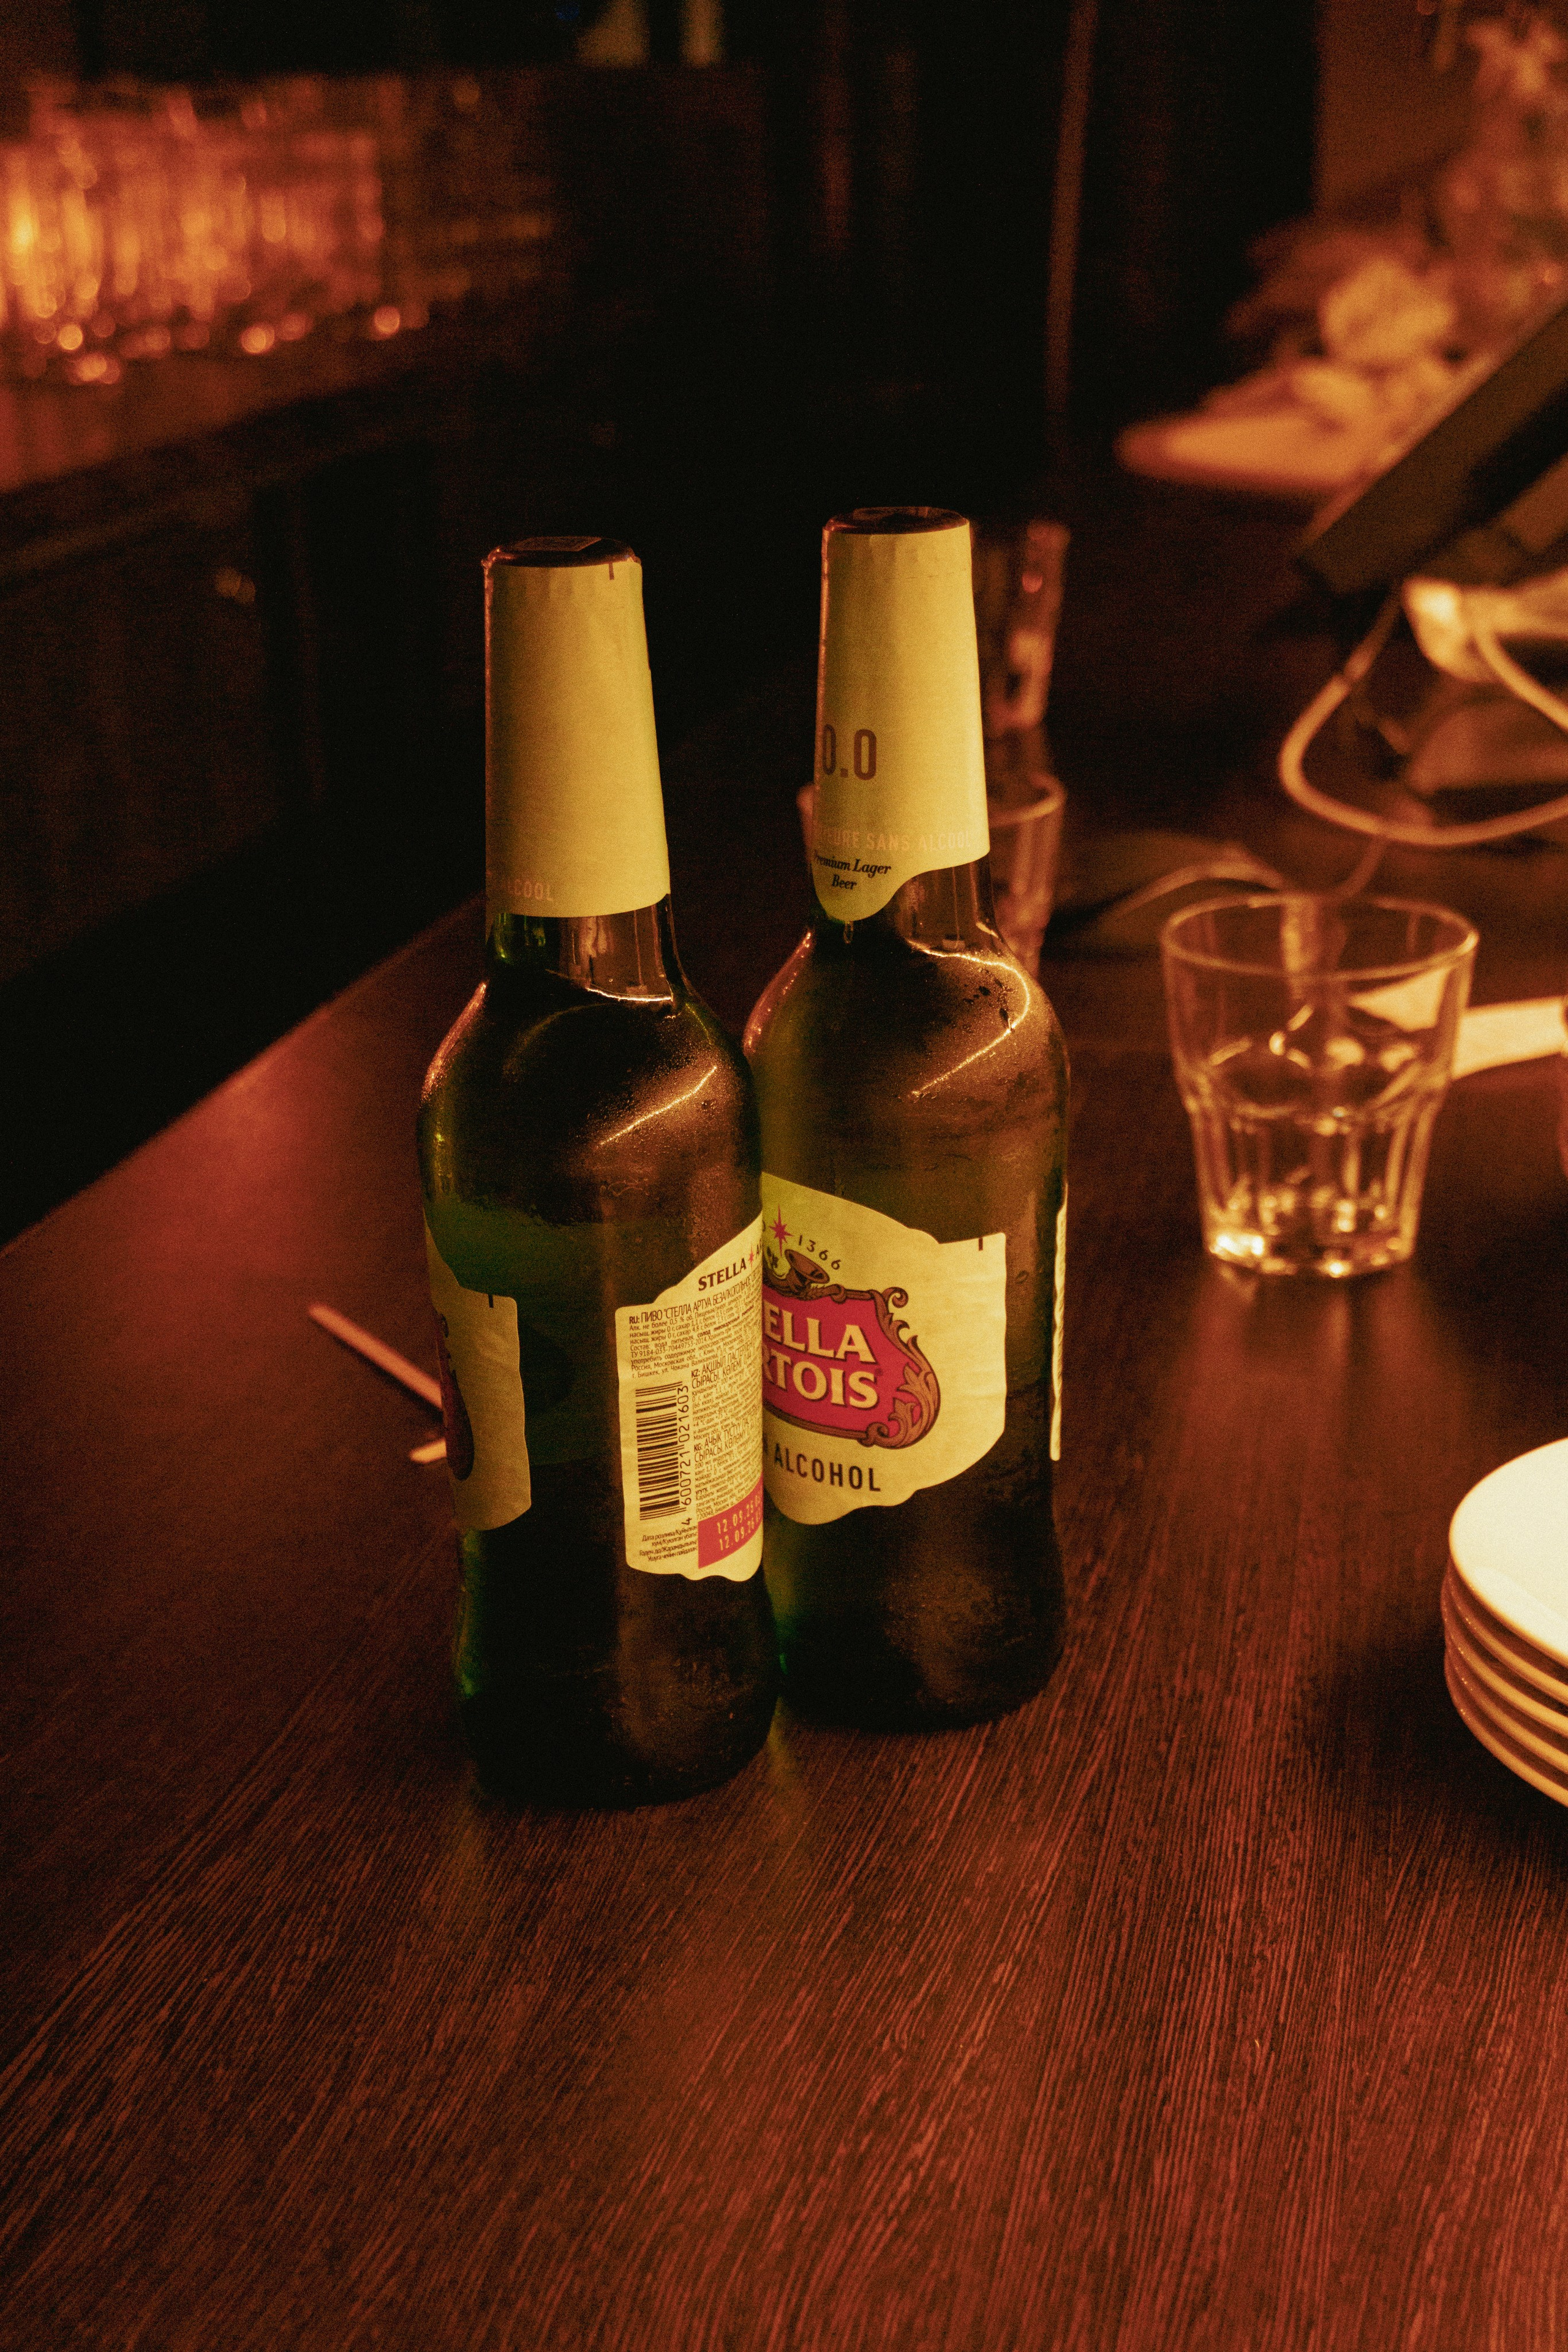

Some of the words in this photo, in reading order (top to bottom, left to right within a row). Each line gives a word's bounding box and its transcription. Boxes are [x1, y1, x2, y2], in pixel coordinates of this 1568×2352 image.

[823, 724, 876, 780] 0.0
[865, 832, 910, 851] SANS
[918, 829, 972, 852] ALCOOL
[831, 874, 858, 890] Beer
[851, 859, 891, 878] Lager
[797, 1234, 842, 1270] 1366
[698, 1257, 747, 1291] STELLA
[641, 1310, 663, 1322] ПИВО
[693, 1297, 711, 1311] АРТУА
[764, 1300, 876, 1365] ELLA
[631, 1356, 662, 1366] употребить
[665, 1348, 695, 1359] содержимое
[654, 1358, 684, 1367] Московская
[677, 1385, 691, 1444] 021603
[679, 1450, 692, 1506] 600721
[774, 1442, 881, 1492] ALCOHOL
[681, 1517, 692, 1526] 4
